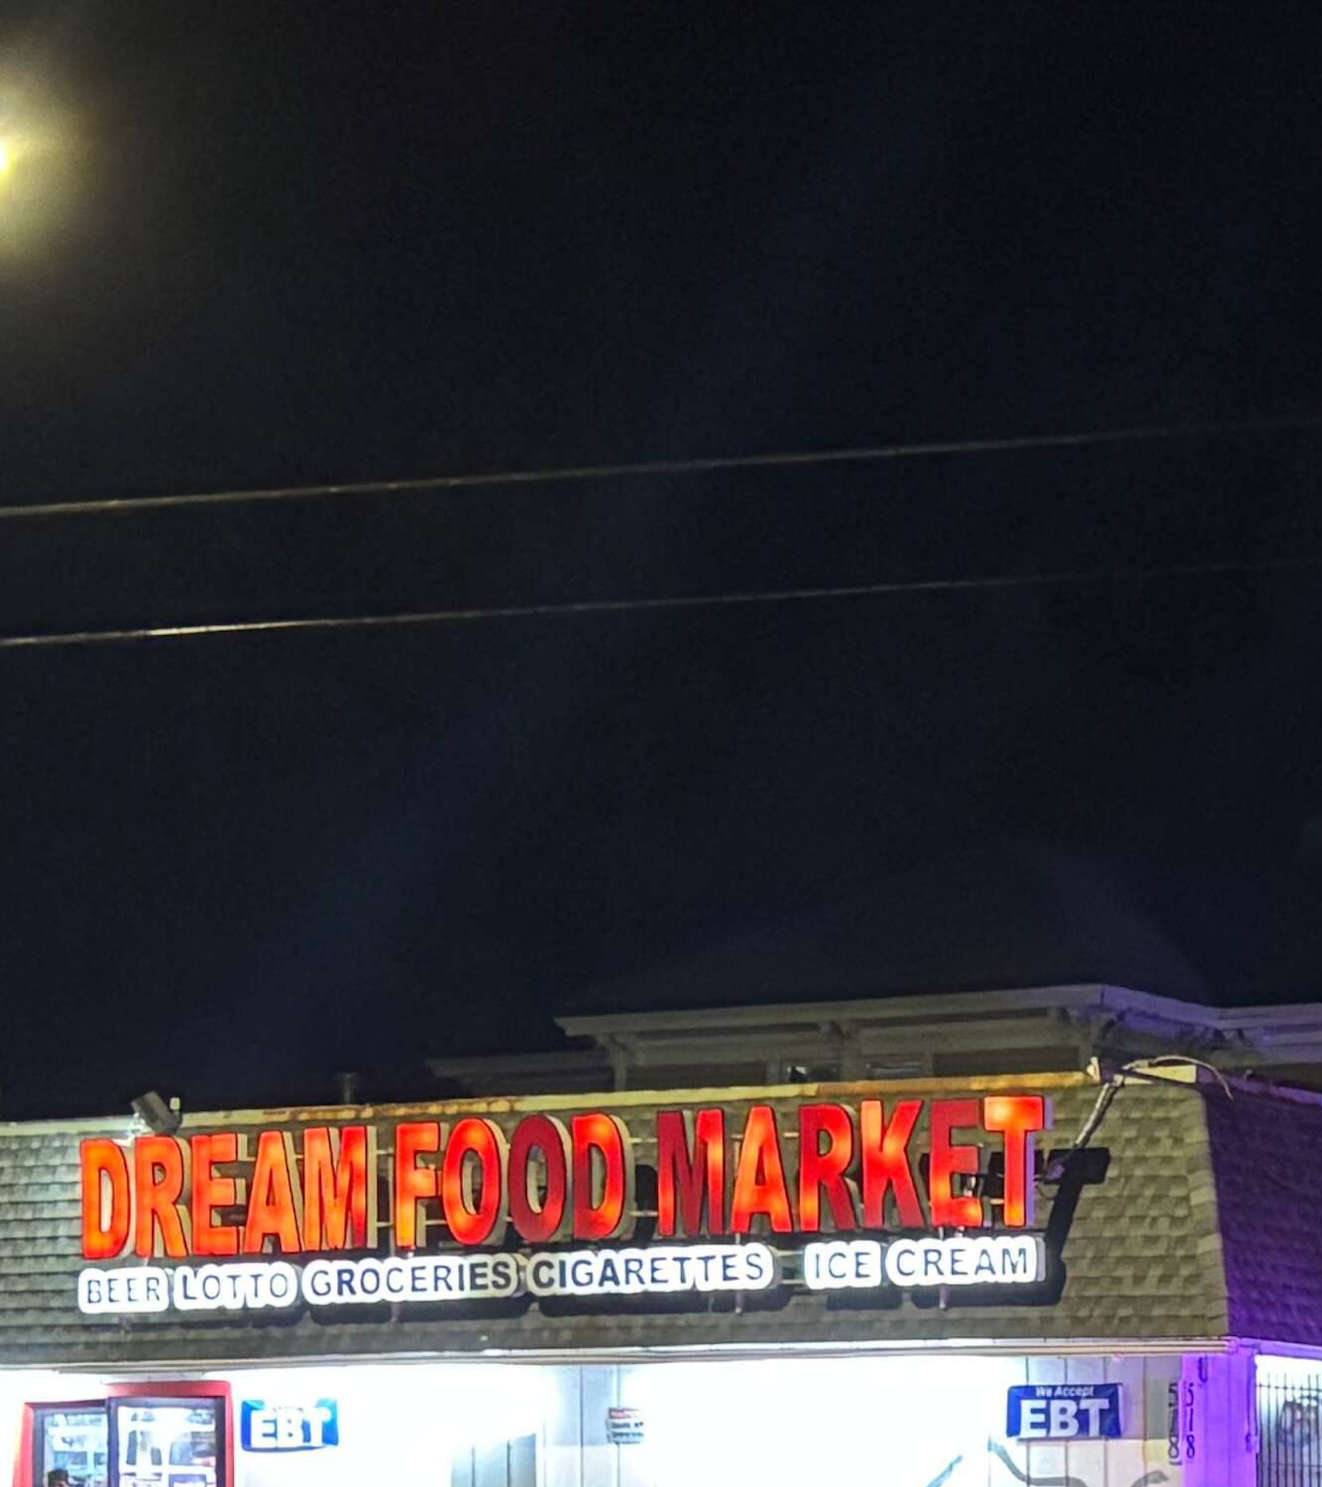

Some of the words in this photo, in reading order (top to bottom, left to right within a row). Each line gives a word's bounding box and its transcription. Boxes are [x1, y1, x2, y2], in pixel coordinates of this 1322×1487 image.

[79, 1125, 370, 1260] DREAM
[395, 1112, 628, 1248] FOOD
[657, 1095, 1046, 1238] MARKET
[86, 1274, 164, 1305] BEER
[182, 1271, 290, 1301] LOTTO
[310, 1258, 512, 1297] GROCERIES
[531, 1251, 766, 1289] CIGARETTES
[811, 1250, 873, 1280] ICE
[894, 1245, 1029, 1277] CREAM
[1054, 1386, 1095, 1399] Accept
[250, 1408, 332, 1448] EBT
[1019, 1398, 1110, 1438] EBT
